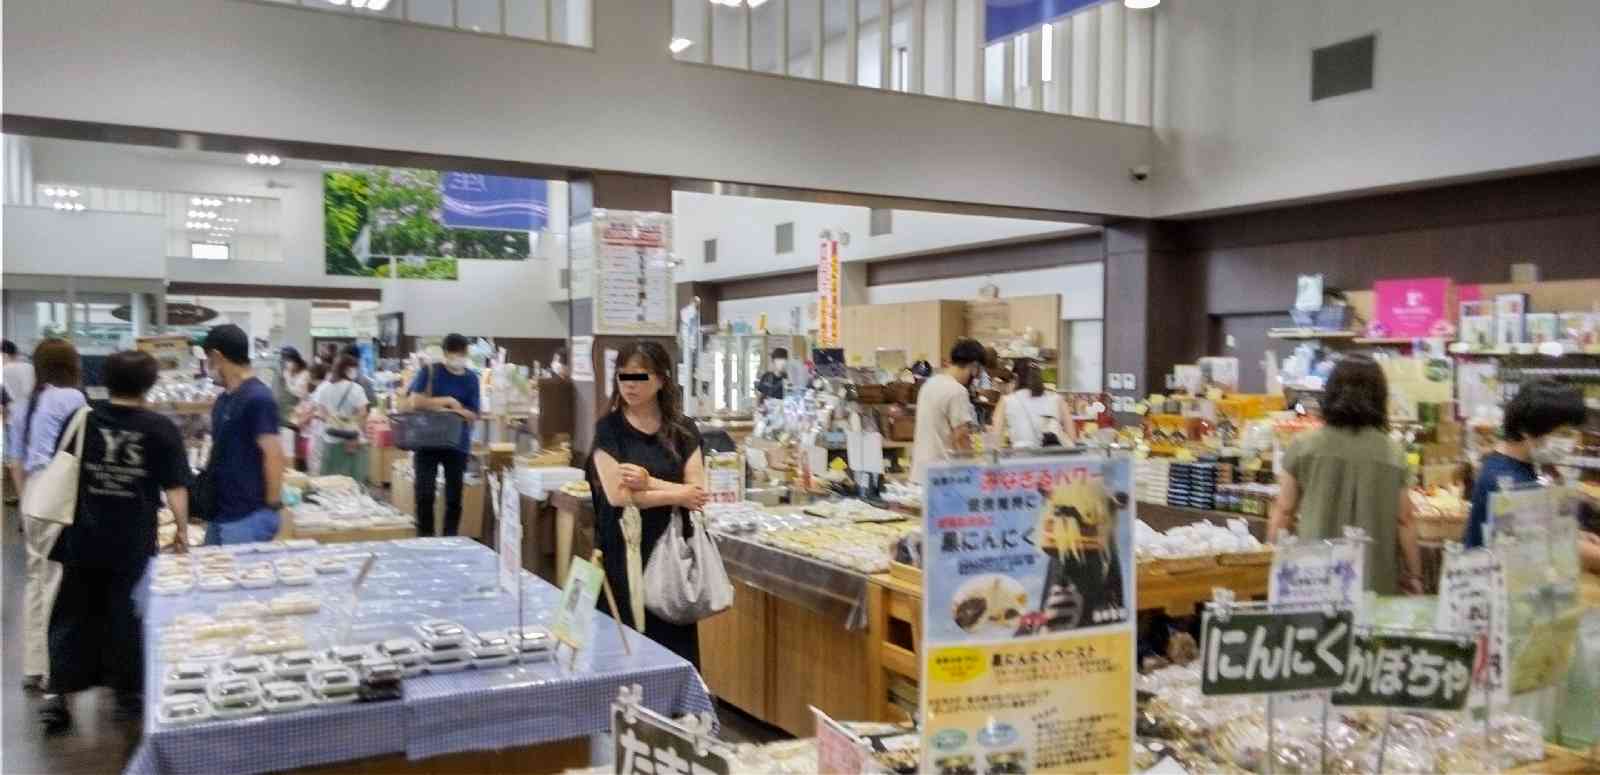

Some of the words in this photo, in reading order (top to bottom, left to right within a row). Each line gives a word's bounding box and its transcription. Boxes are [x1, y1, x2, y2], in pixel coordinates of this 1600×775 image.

[941, 526, 1036, 552] 黒にんにく
[1207, 621, 1349, 684] にんにく
